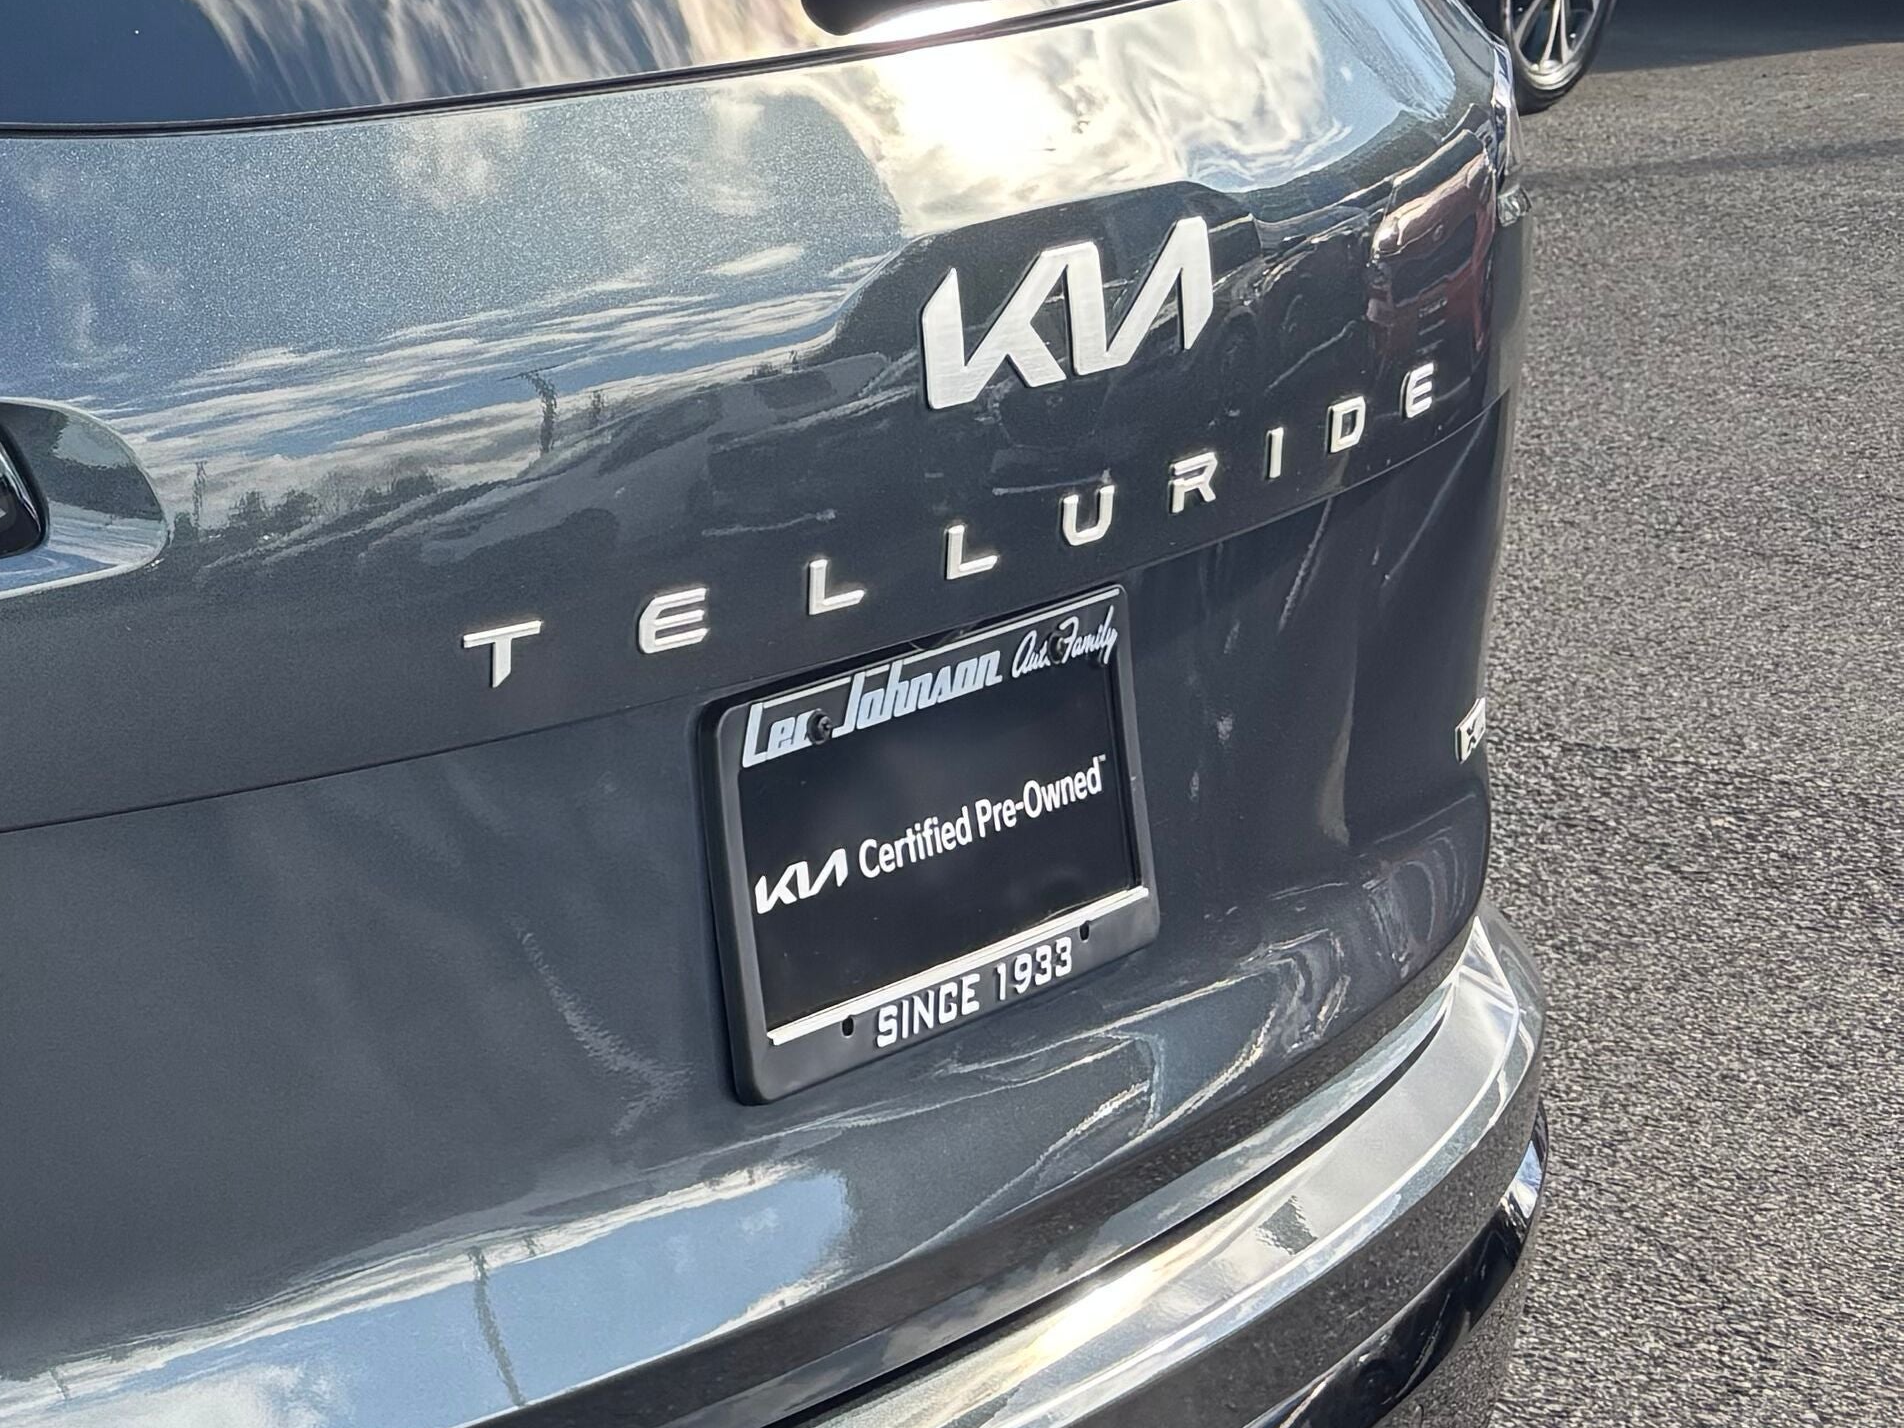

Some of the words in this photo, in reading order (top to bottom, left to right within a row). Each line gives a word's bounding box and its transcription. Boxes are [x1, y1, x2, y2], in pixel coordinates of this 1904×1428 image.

[922, 216, 1214, 410] KIA
[463, 363, 1435, 687] TELLURIDE
[831, 650, 1003, 738] Johnson
[1059, 605, 1118, 664] Family
[755, 848, 847, 914] KIA
[859, 806, 972, 878] Certified
[877, 972, 980, 1048] SINCE
[995, 936, 1072, 1000] 1933
